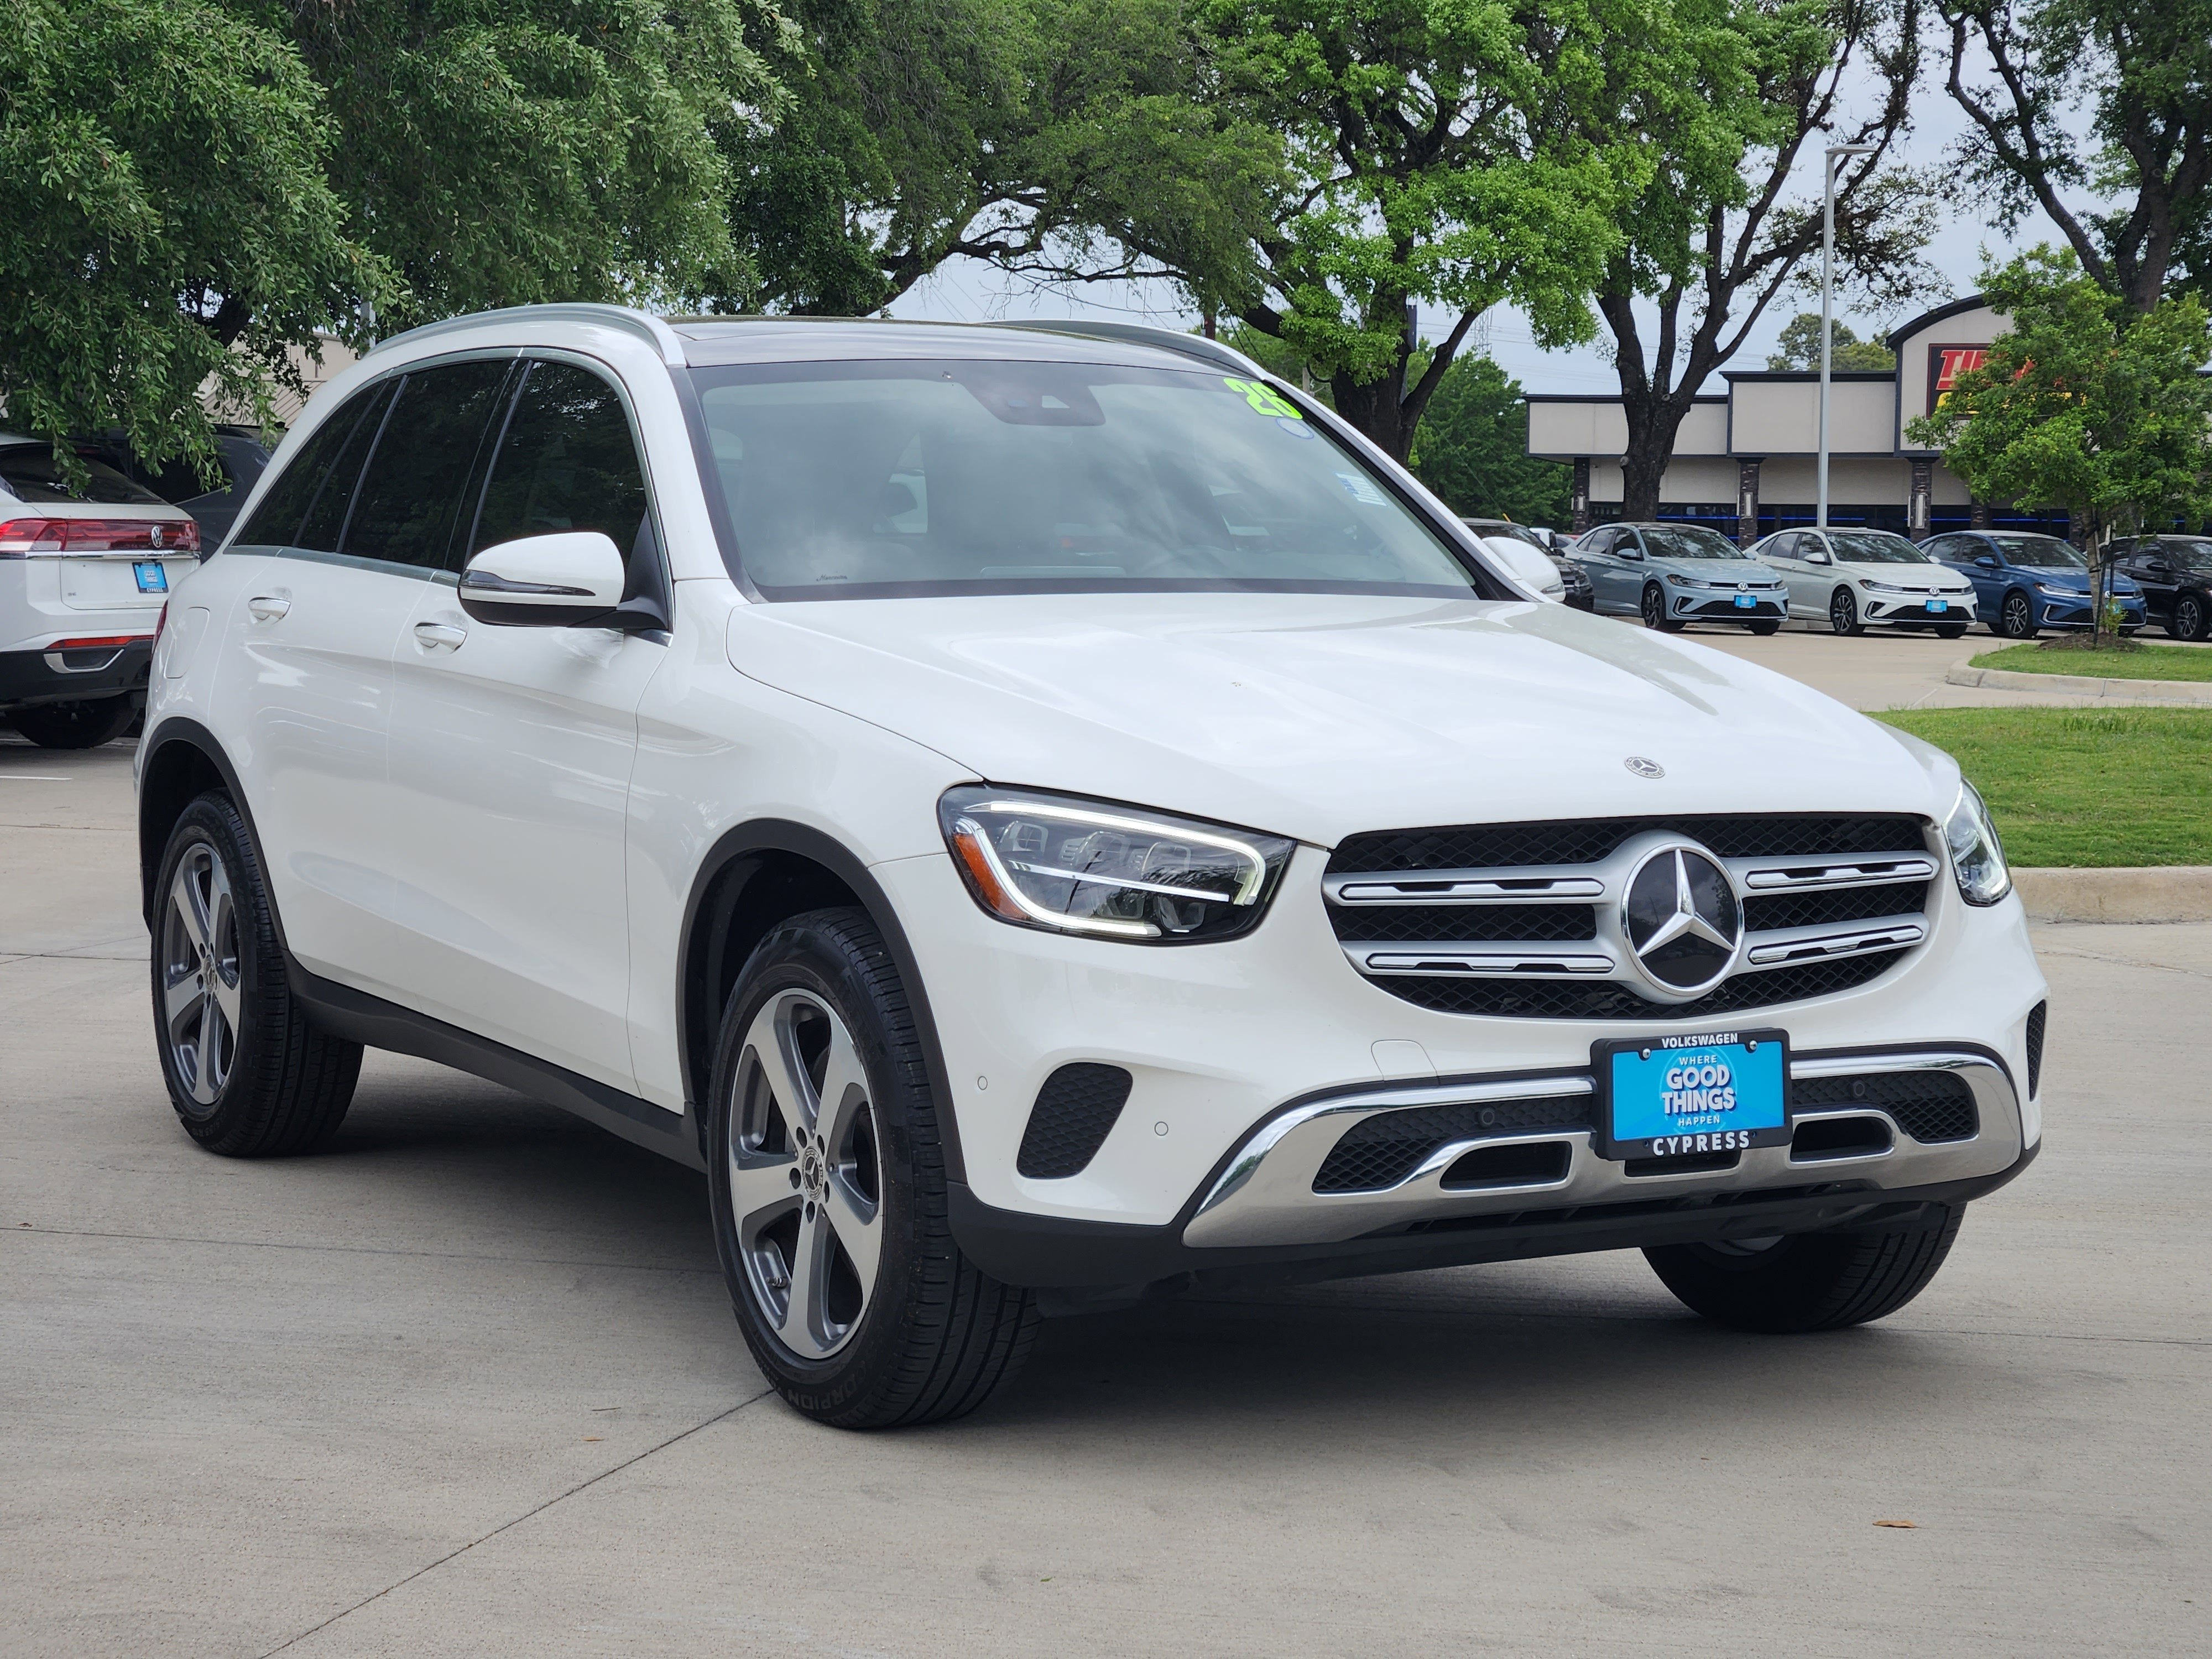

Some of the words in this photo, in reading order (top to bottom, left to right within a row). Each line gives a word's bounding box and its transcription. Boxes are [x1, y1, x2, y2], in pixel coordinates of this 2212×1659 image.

[1662, 1033, 1738, 1048] VOLKSWAGEN
[1679, 1055, 1718, 1065] WHERE
[1666, 1065, 1730, 1089] GOOD
[1662, 1087, 1735, 1114] THINGS
[1678, 1115, 1721, 1126] HAPPEN
[1653, 1130, 1750, 1156] CYPRESS
